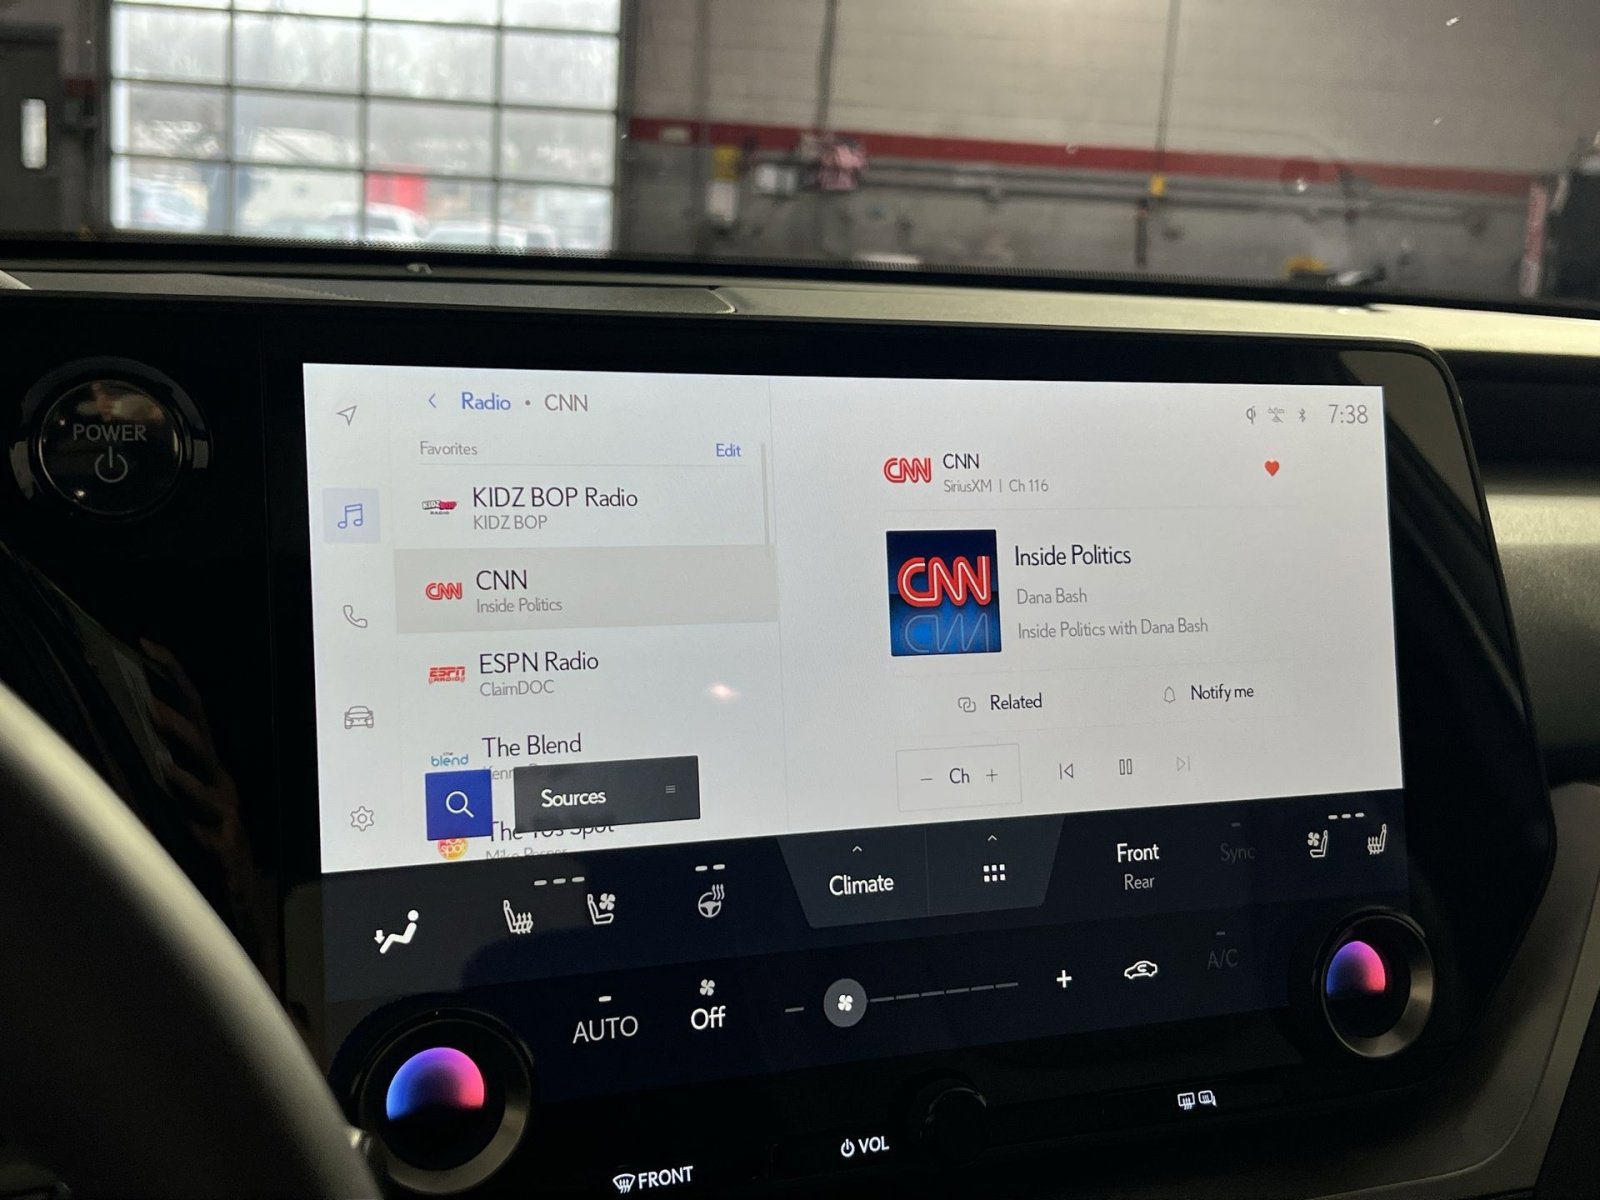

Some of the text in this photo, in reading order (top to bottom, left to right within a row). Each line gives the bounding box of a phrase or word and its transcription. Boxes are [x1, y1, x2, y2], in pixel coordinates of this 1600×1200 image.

[461, 391, 512, 411] Radio
[544, 393, 589, 412] CNN
[1328, 403, 1369, 425] 7:38
[72, 423, 147, 441] POWER
[419, 440, 478, 456] Favorites
[715, 443, 742, 458] Edit
[883, 457, 932, 484] CNN
[943, 453, 980, 470] CNN
[943, 478, 1049, 493] SiriusXM Ch 116
[473, 486, 638, 508] KIDZ BOP Radio
[473, 514, 548, 531] KIDZ BOP
[1015, 543, 1132, 567] Inside Politics
[476, 569, 528, 591] CNN
[897, 555, 992, 608] CNN
[425, 582, 463, 601] CNN
[1016, 587, 1088, 605] Dana Bash
[476, 597, 563, 614] Inside Politics
[1017, 617, 1209, 639] Inside Politics with Dana Bash
[430, 666, 466, 677] ESPN
[479, 650, 599, 675] ESPN Radio
[479, 679, 555, 697] ClaimDOC
[1190, 683, 1254, 703] Notify me
[990, 692, 1043, 711] Related
[482, 732, 582, 758] The Blend
[430, 753, 469, 767] blend
[949, 767, 970, 785] Ch
[540, 788, 607, 808] Sources
[1116, 842, 1160, 863] Front
[1220, 842, 1257, 866] Sync
[828, 874, 895, 896] Climate
[1124, 873, 1156, 891] Rear
[1207, 948, 1239, 970] A/C
[690, 1005, 727, 1030] Off
[572, 1015, 639, 1044] AUTO
[857, 1135, 891, 1154] VOL
[638, 1165, 694, 1190] FRONT
